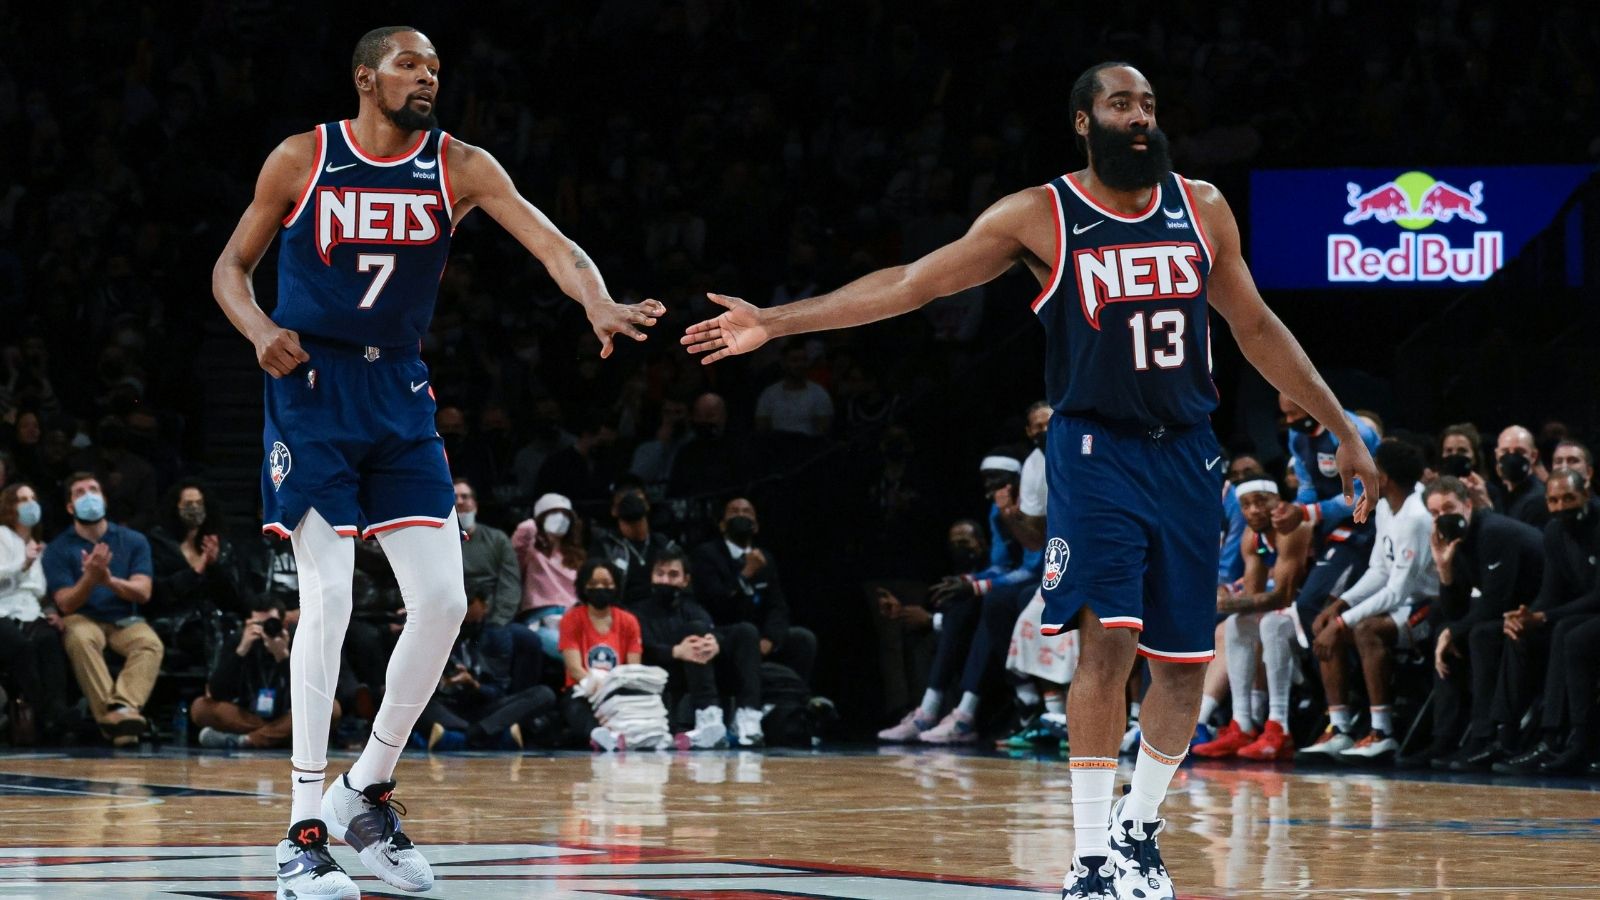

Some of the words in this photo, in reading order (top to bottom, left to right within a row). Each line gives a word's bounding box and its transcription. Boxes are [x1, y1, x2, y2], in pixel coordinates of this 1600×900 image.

[412, 171, 436, 180] Webull
[315, 186, 443, 267] NETS
[357, 253, 396, 309] 7
[1072, 241, 1203, 331] NETS
[1328, 232, 1416, 282] Red
[1417, 231, 1503, 282] Bull
[1128, 309, 1186, 371] 13
